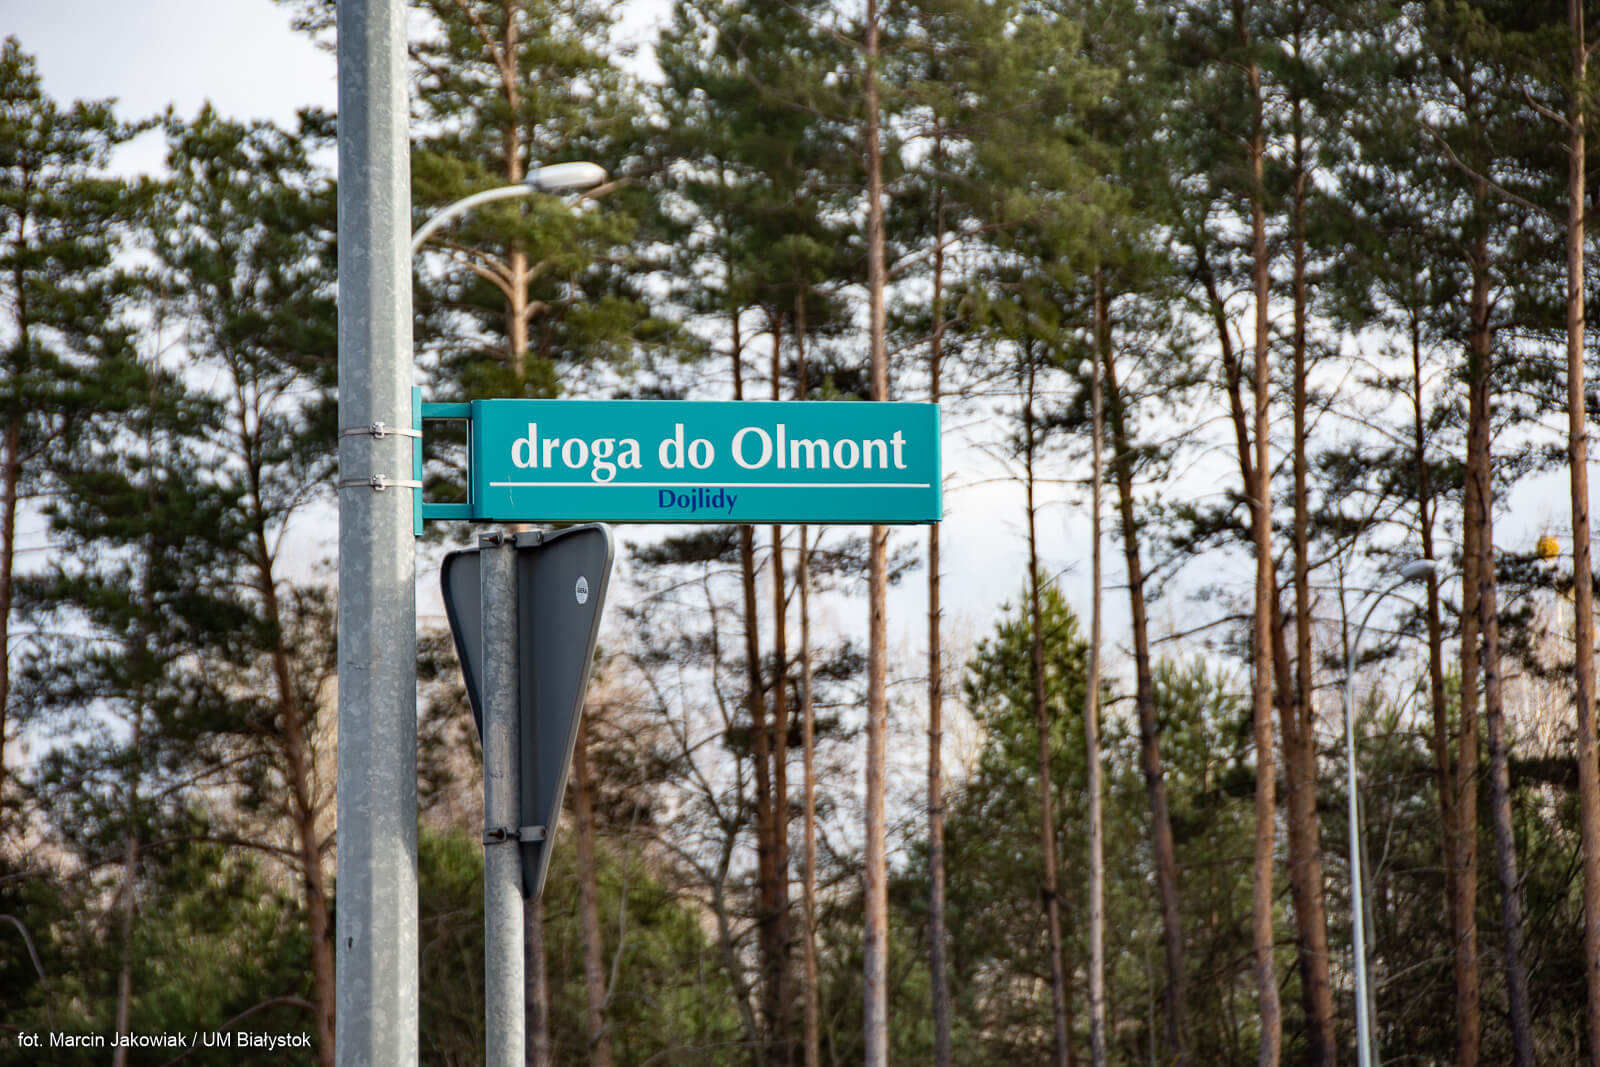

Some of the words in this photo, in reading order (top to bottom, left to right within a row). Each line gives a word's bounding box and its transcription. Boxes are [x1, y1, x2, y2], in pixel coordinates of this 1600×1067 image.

[512, 423, 642, 482] droga
[658, 423, 714, 469] do
[731, 423, 907, 469] Olmont
[658, 488, 737, 514] Dojlidy
